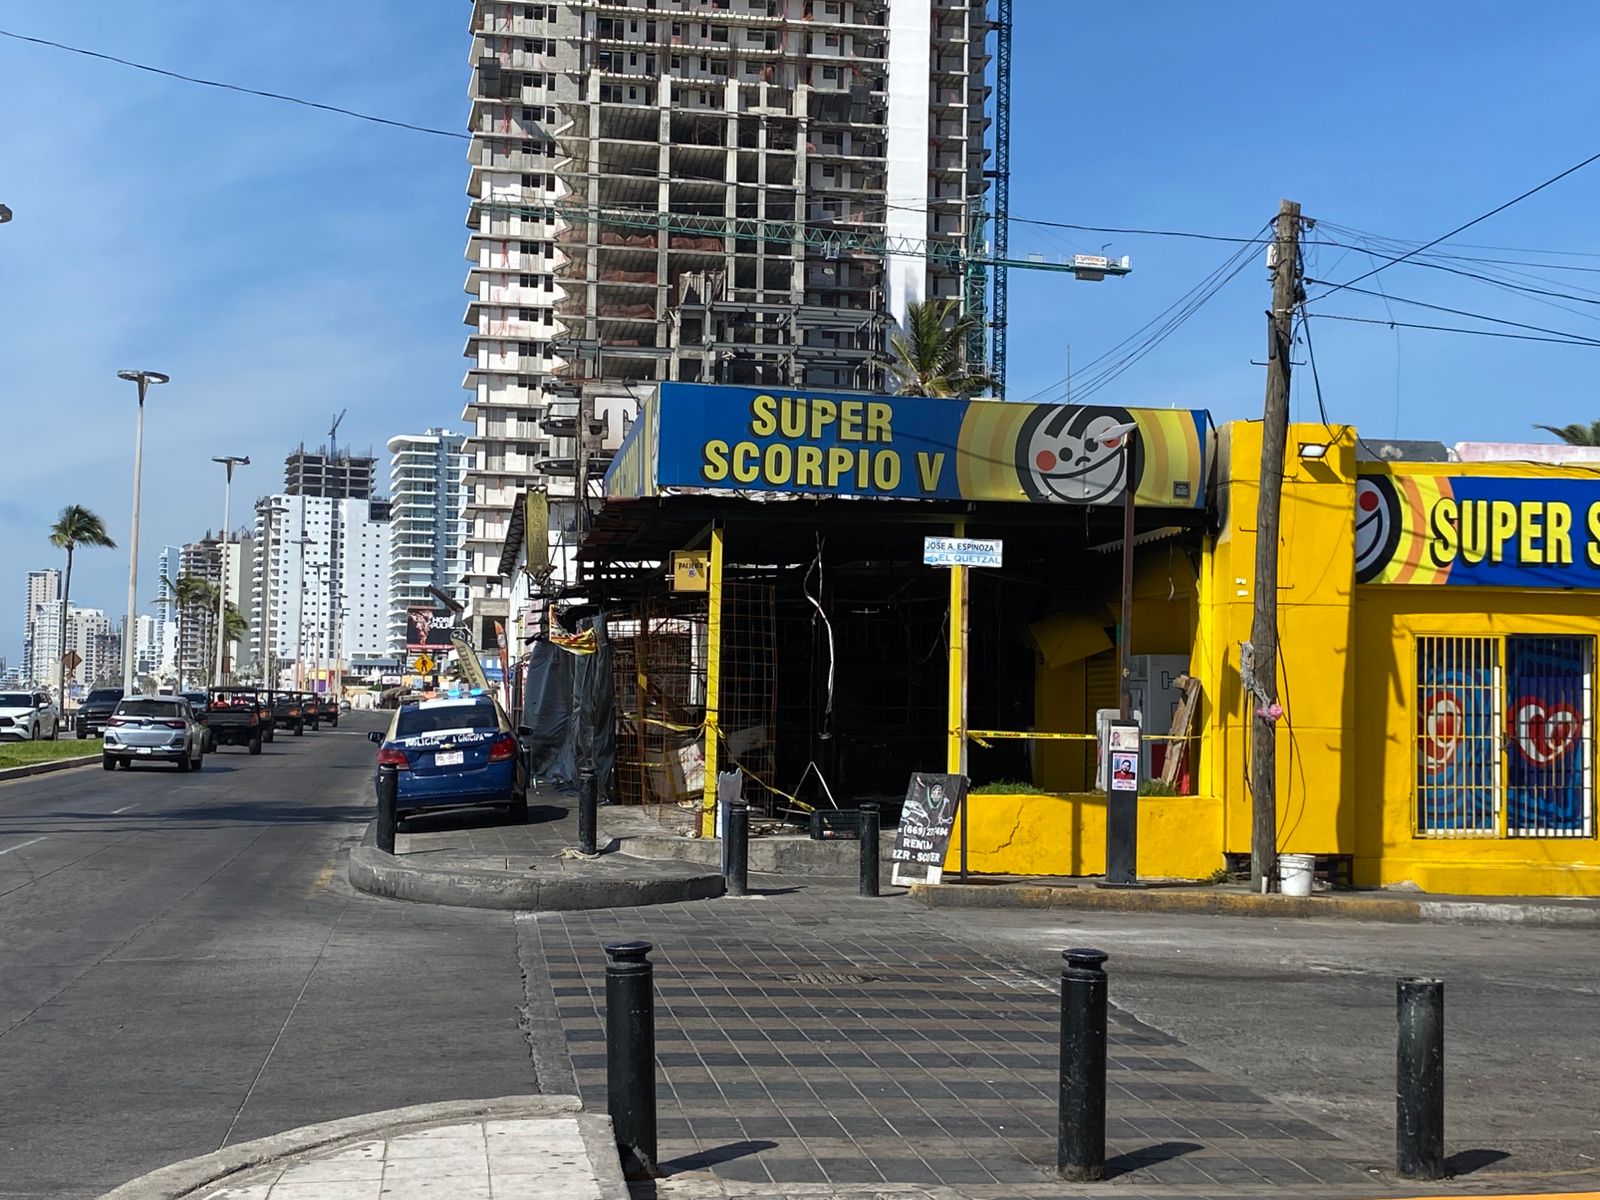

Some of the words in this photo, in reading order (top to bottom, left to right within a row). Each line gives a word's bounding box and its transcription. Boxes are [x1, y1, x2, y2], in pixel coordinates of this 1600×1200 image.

[751, 394, 894, 443] SUPER
[702, 439, 901, 491] SCORPIO
[916, 452, 945, 492] V
[957, 543, 994, 552] ESPINOZA
[1431, 497, 1574, 566] SUPER
[939, 553, 952, 562] EL
[954, 554, 1001, 564] QUETZAL
